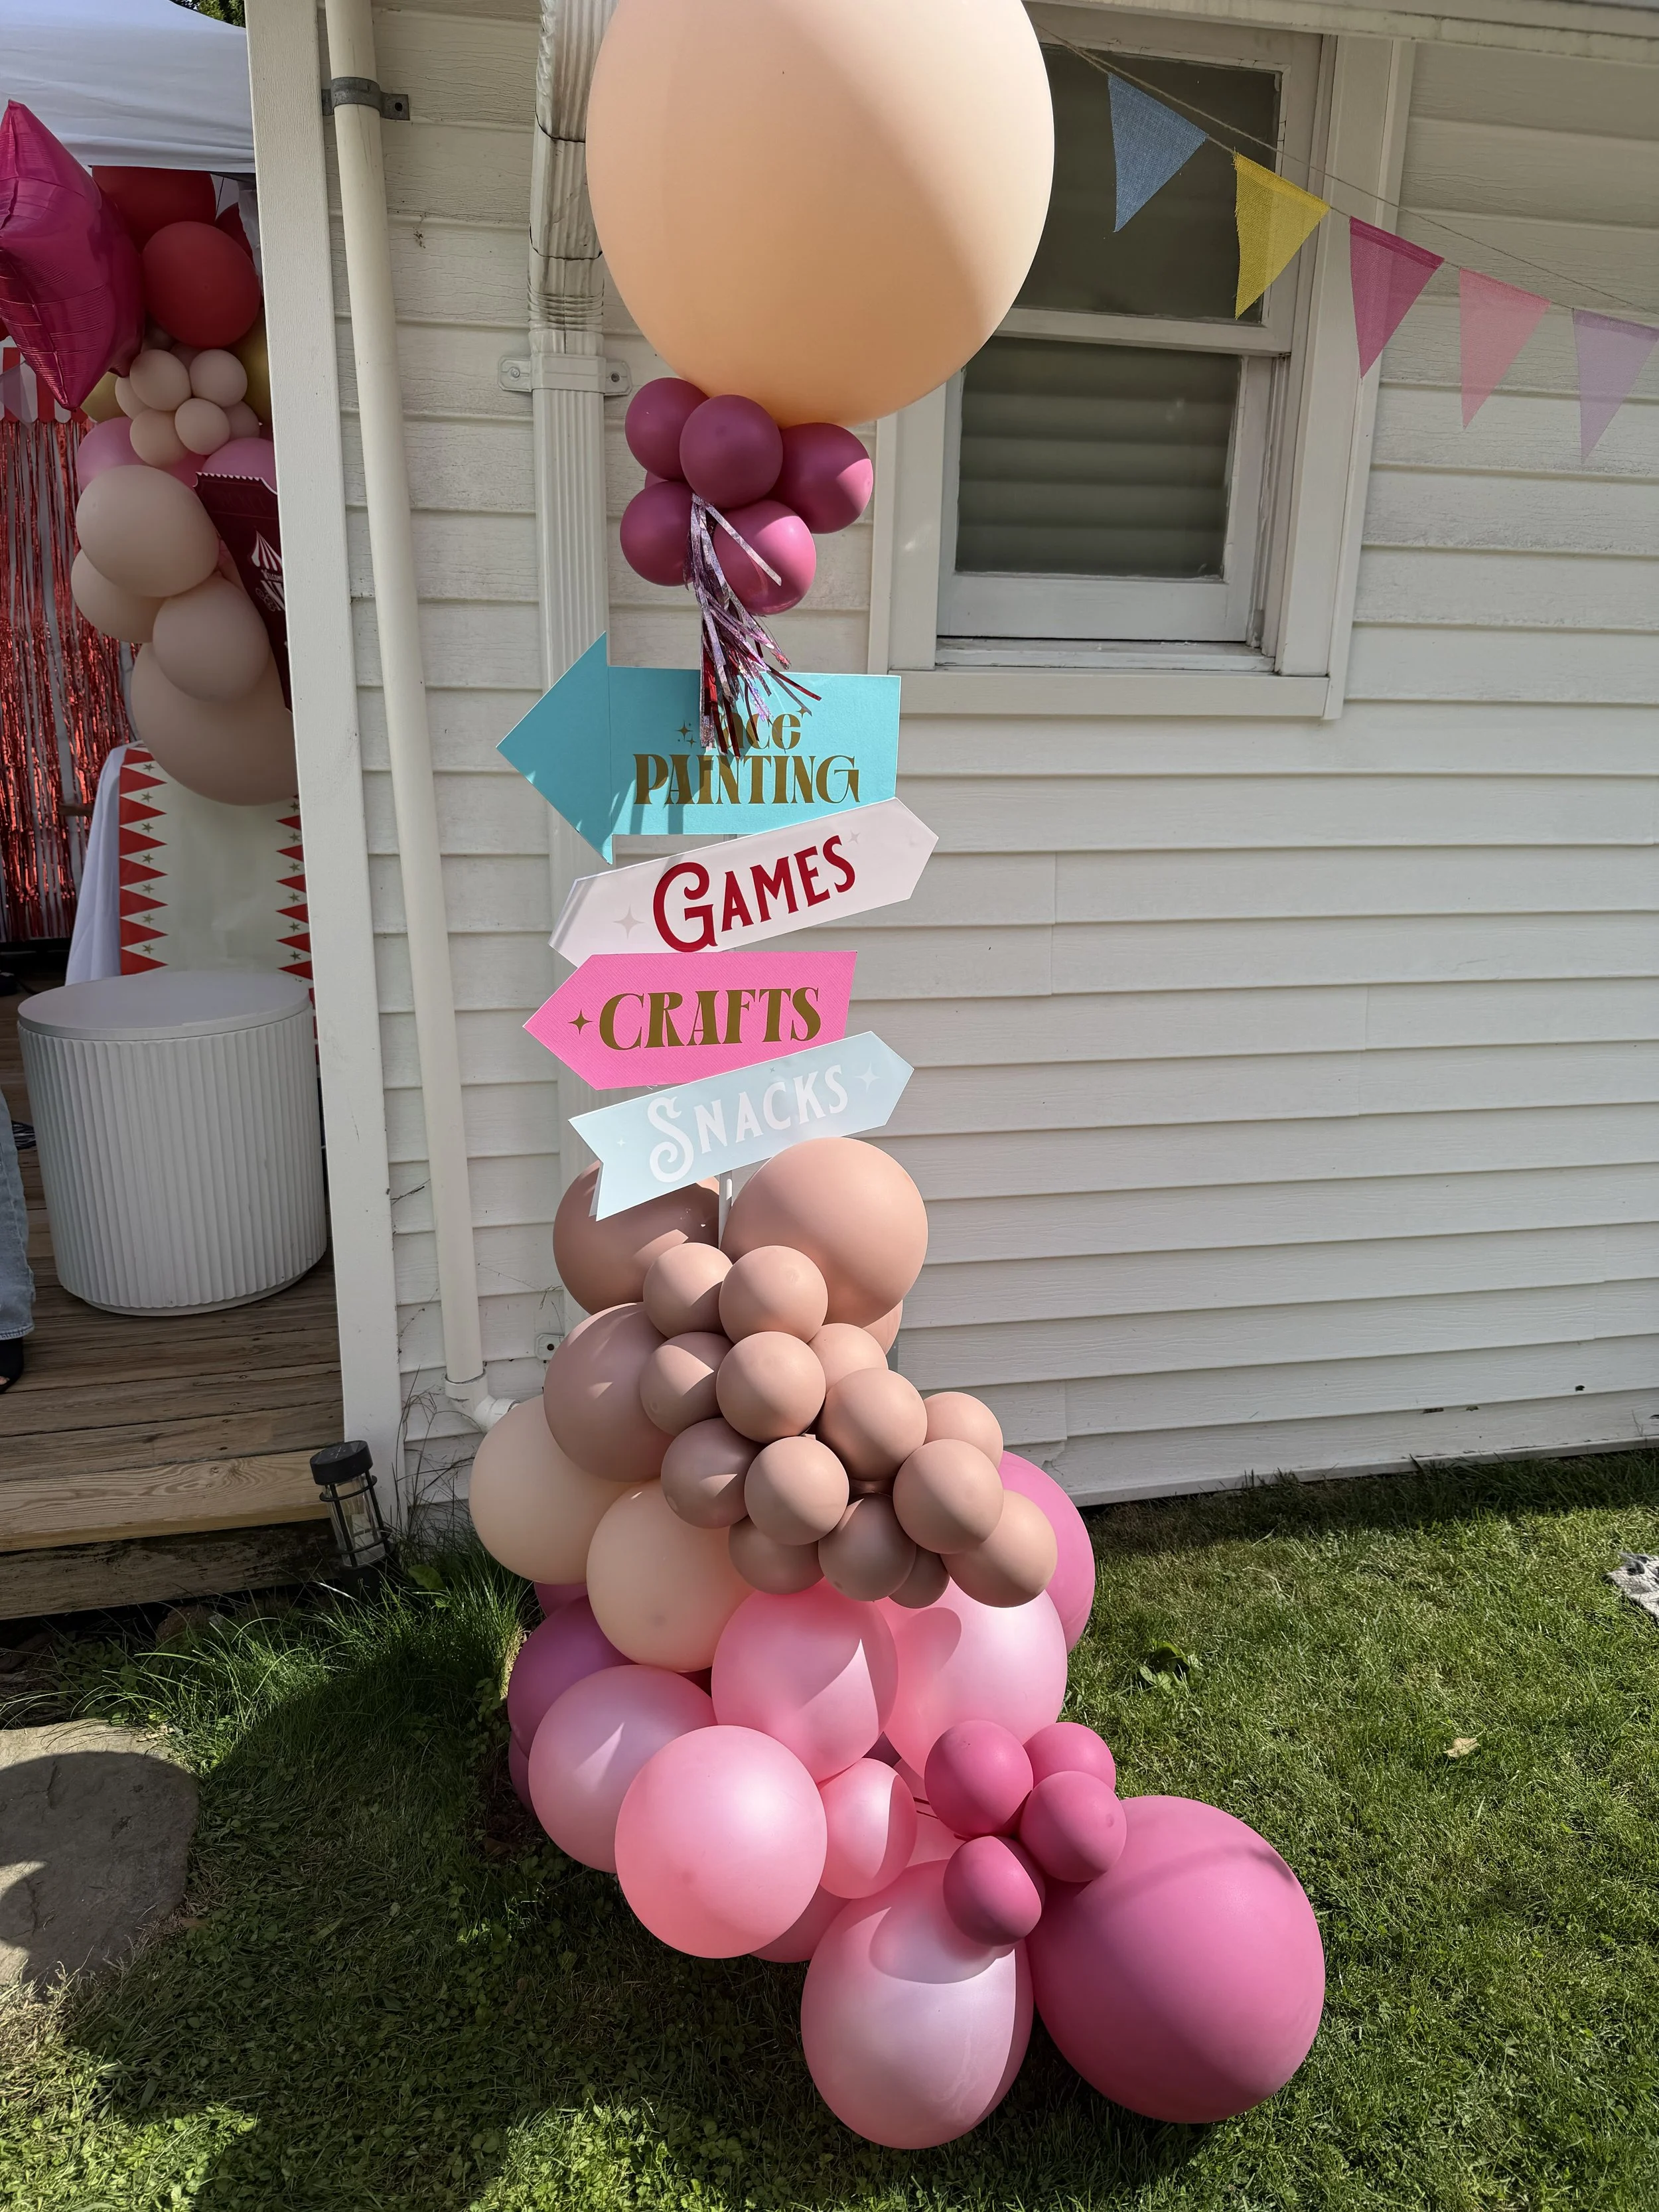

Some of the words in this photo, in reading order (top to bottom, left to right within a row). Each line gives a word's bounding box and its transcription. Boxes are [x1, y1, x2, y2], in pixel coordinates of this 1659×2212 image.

[701, 712, 801, 750] ace
[634, 755, 859, 805] PAINTING
[652, 835, 855, 952] GAMES
[599, 987, 822, 1051] CRAFTS
[647, 1065, 849, 1183] SNACKS
